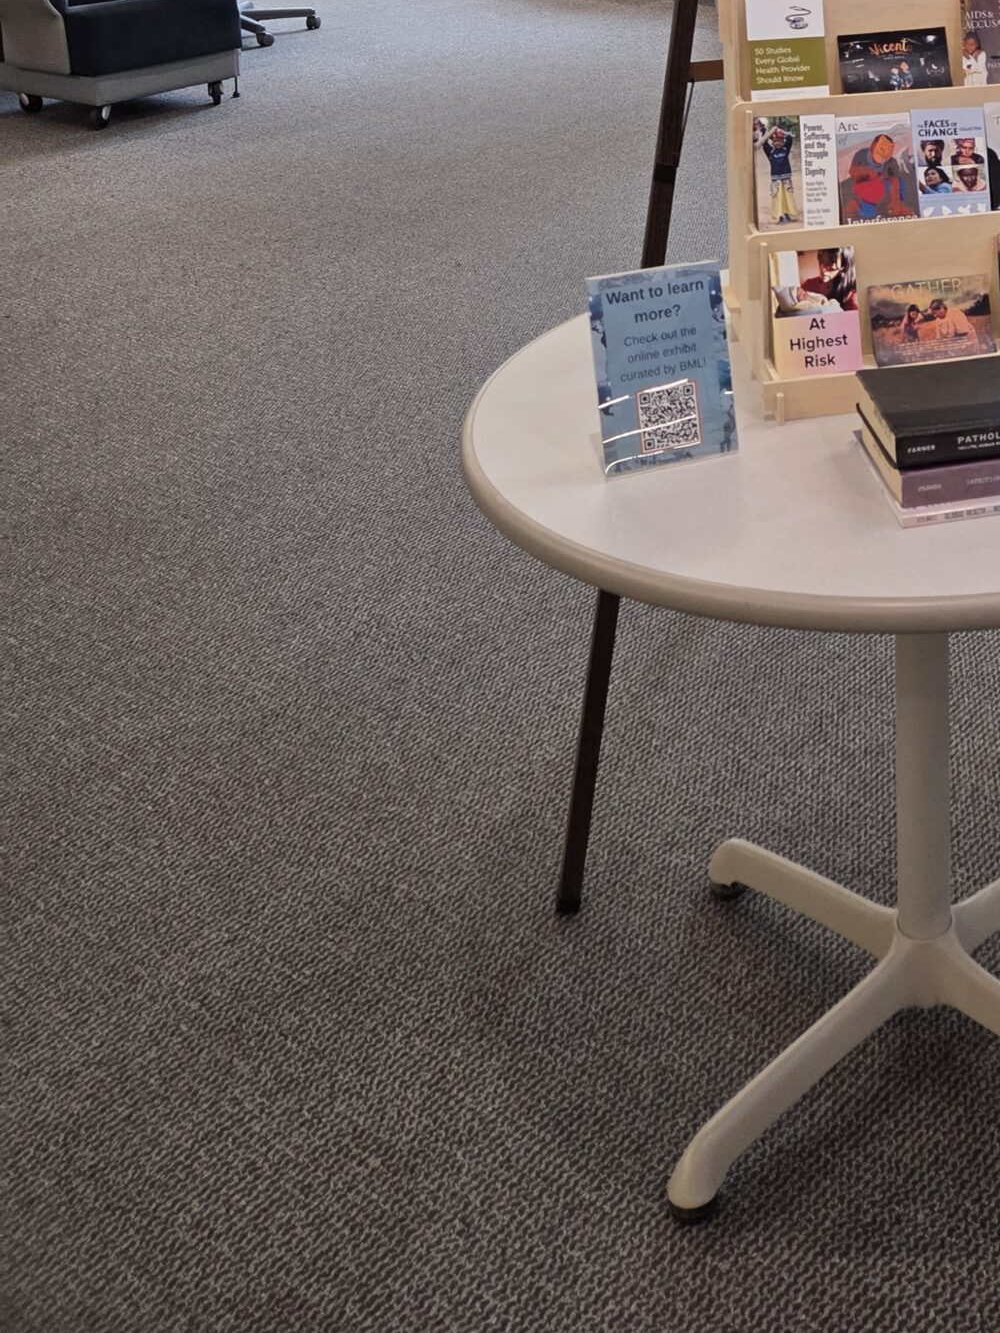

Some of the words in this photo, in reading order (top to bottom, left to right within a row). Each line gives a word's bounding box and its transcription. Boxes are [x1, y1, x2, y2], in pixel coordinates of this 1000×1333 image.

[838, 122, 858, 132] Arc
[924, 120, 950, 128] FACES
[918, 128, 958, 137] CHANGE
[804, 150, 828, 159] Struggle
[805, 168, 825, 177] Dignity
[606, 287, 645, 305] Want
[649, 287, 663, 299] to
[668, 279, 704, 295] learn
[891, 278, 962, 299] GATHER
[634, 304, 681, 323] more?
[809, 318, 826, 330] At
[624, 332, 657, 347] Check
[661, 329, 678, 341] out
[680, 326, 697, 337] the
[790, 334, 848, 352] Highest
[628, 348, 659, 364] online
[663, 343, 697, 358] exhibit
[805, 354, 836, 368] Risk
[620, 367, 661, 383] curated
[664, 365, 676, 377] by
[680, 358, 707, 372] BML!
[907, 444, 935, 453] FARMER
